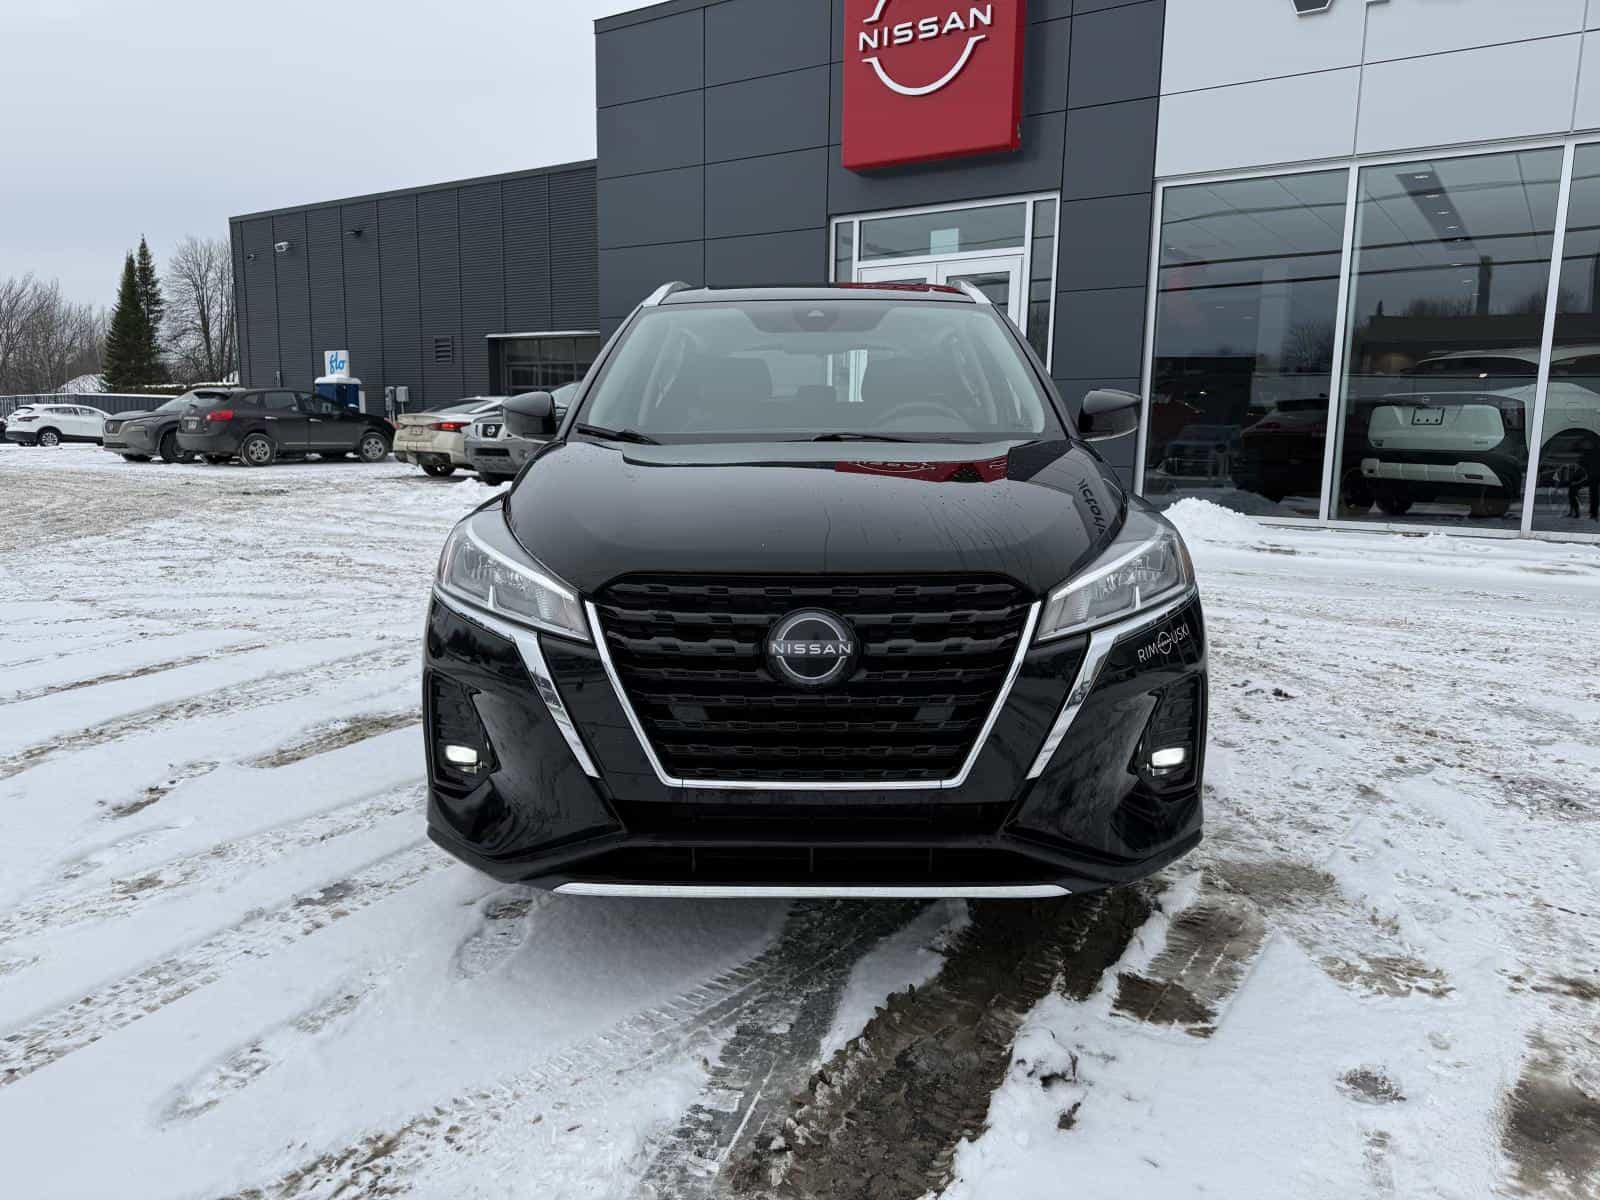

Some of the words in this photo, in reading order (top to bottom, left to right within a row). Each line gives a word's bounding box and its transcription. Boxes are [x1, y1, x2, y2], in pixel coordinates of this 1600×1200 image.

[858, 4, 992, 51] NISSAN
[329, 351, 346, 374] flo
[772, 643, 851, 654] NISSAN
